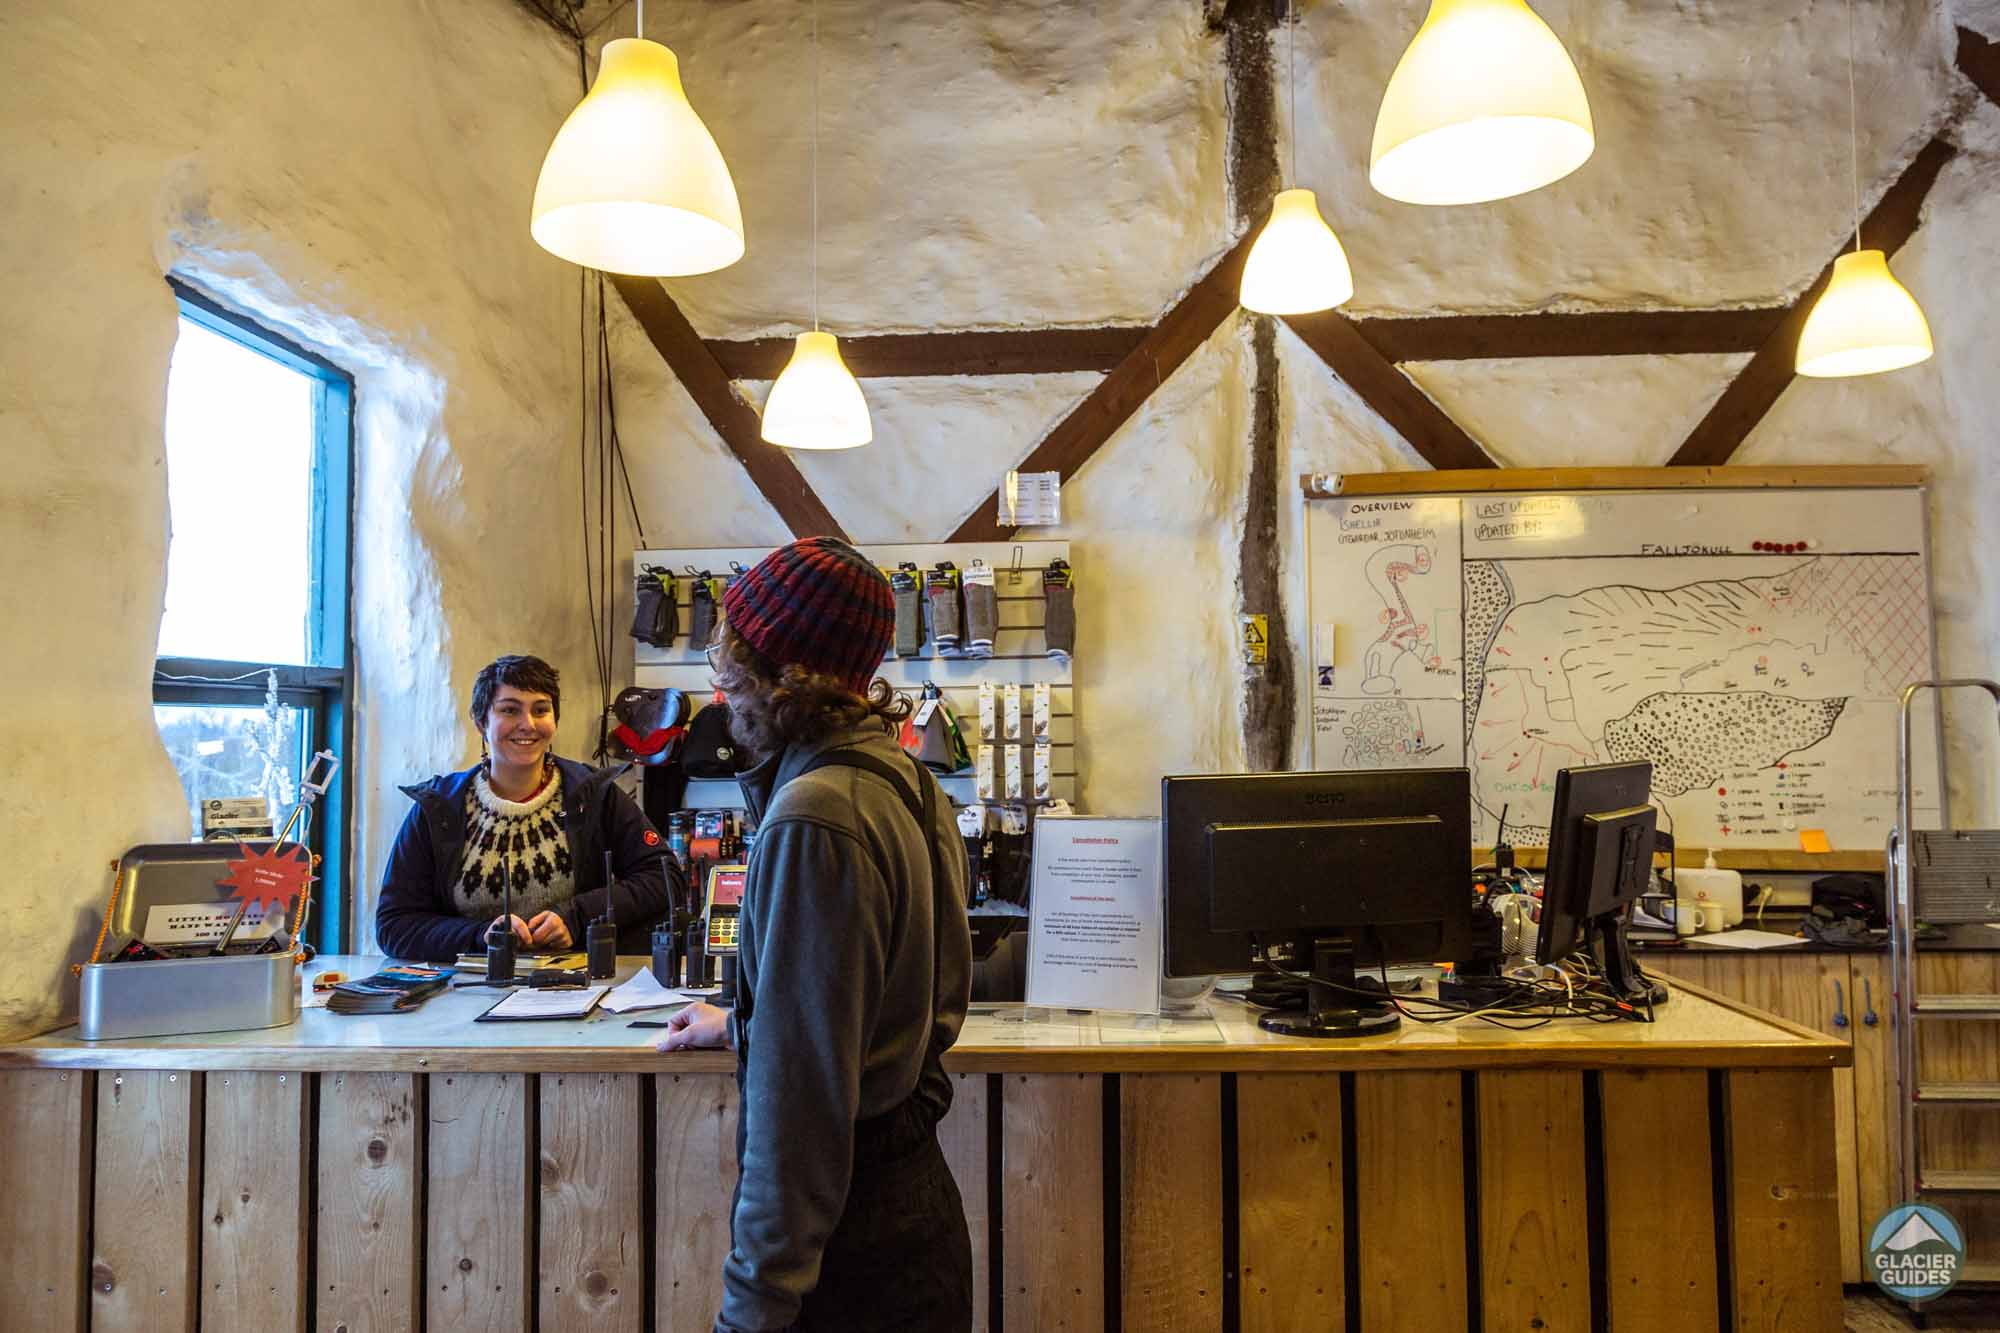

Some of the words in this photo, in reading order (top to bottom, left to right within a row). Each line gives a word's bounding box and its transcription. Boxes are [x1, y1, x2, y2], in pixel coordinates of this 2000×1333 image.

[1351, 502, 1414, 514] OVERVIEW
[1475, 502, 1506, 518] LAST
[1474, 522, 1519, 540] UPDATED
[210, 812, 239, 820] Glacier
